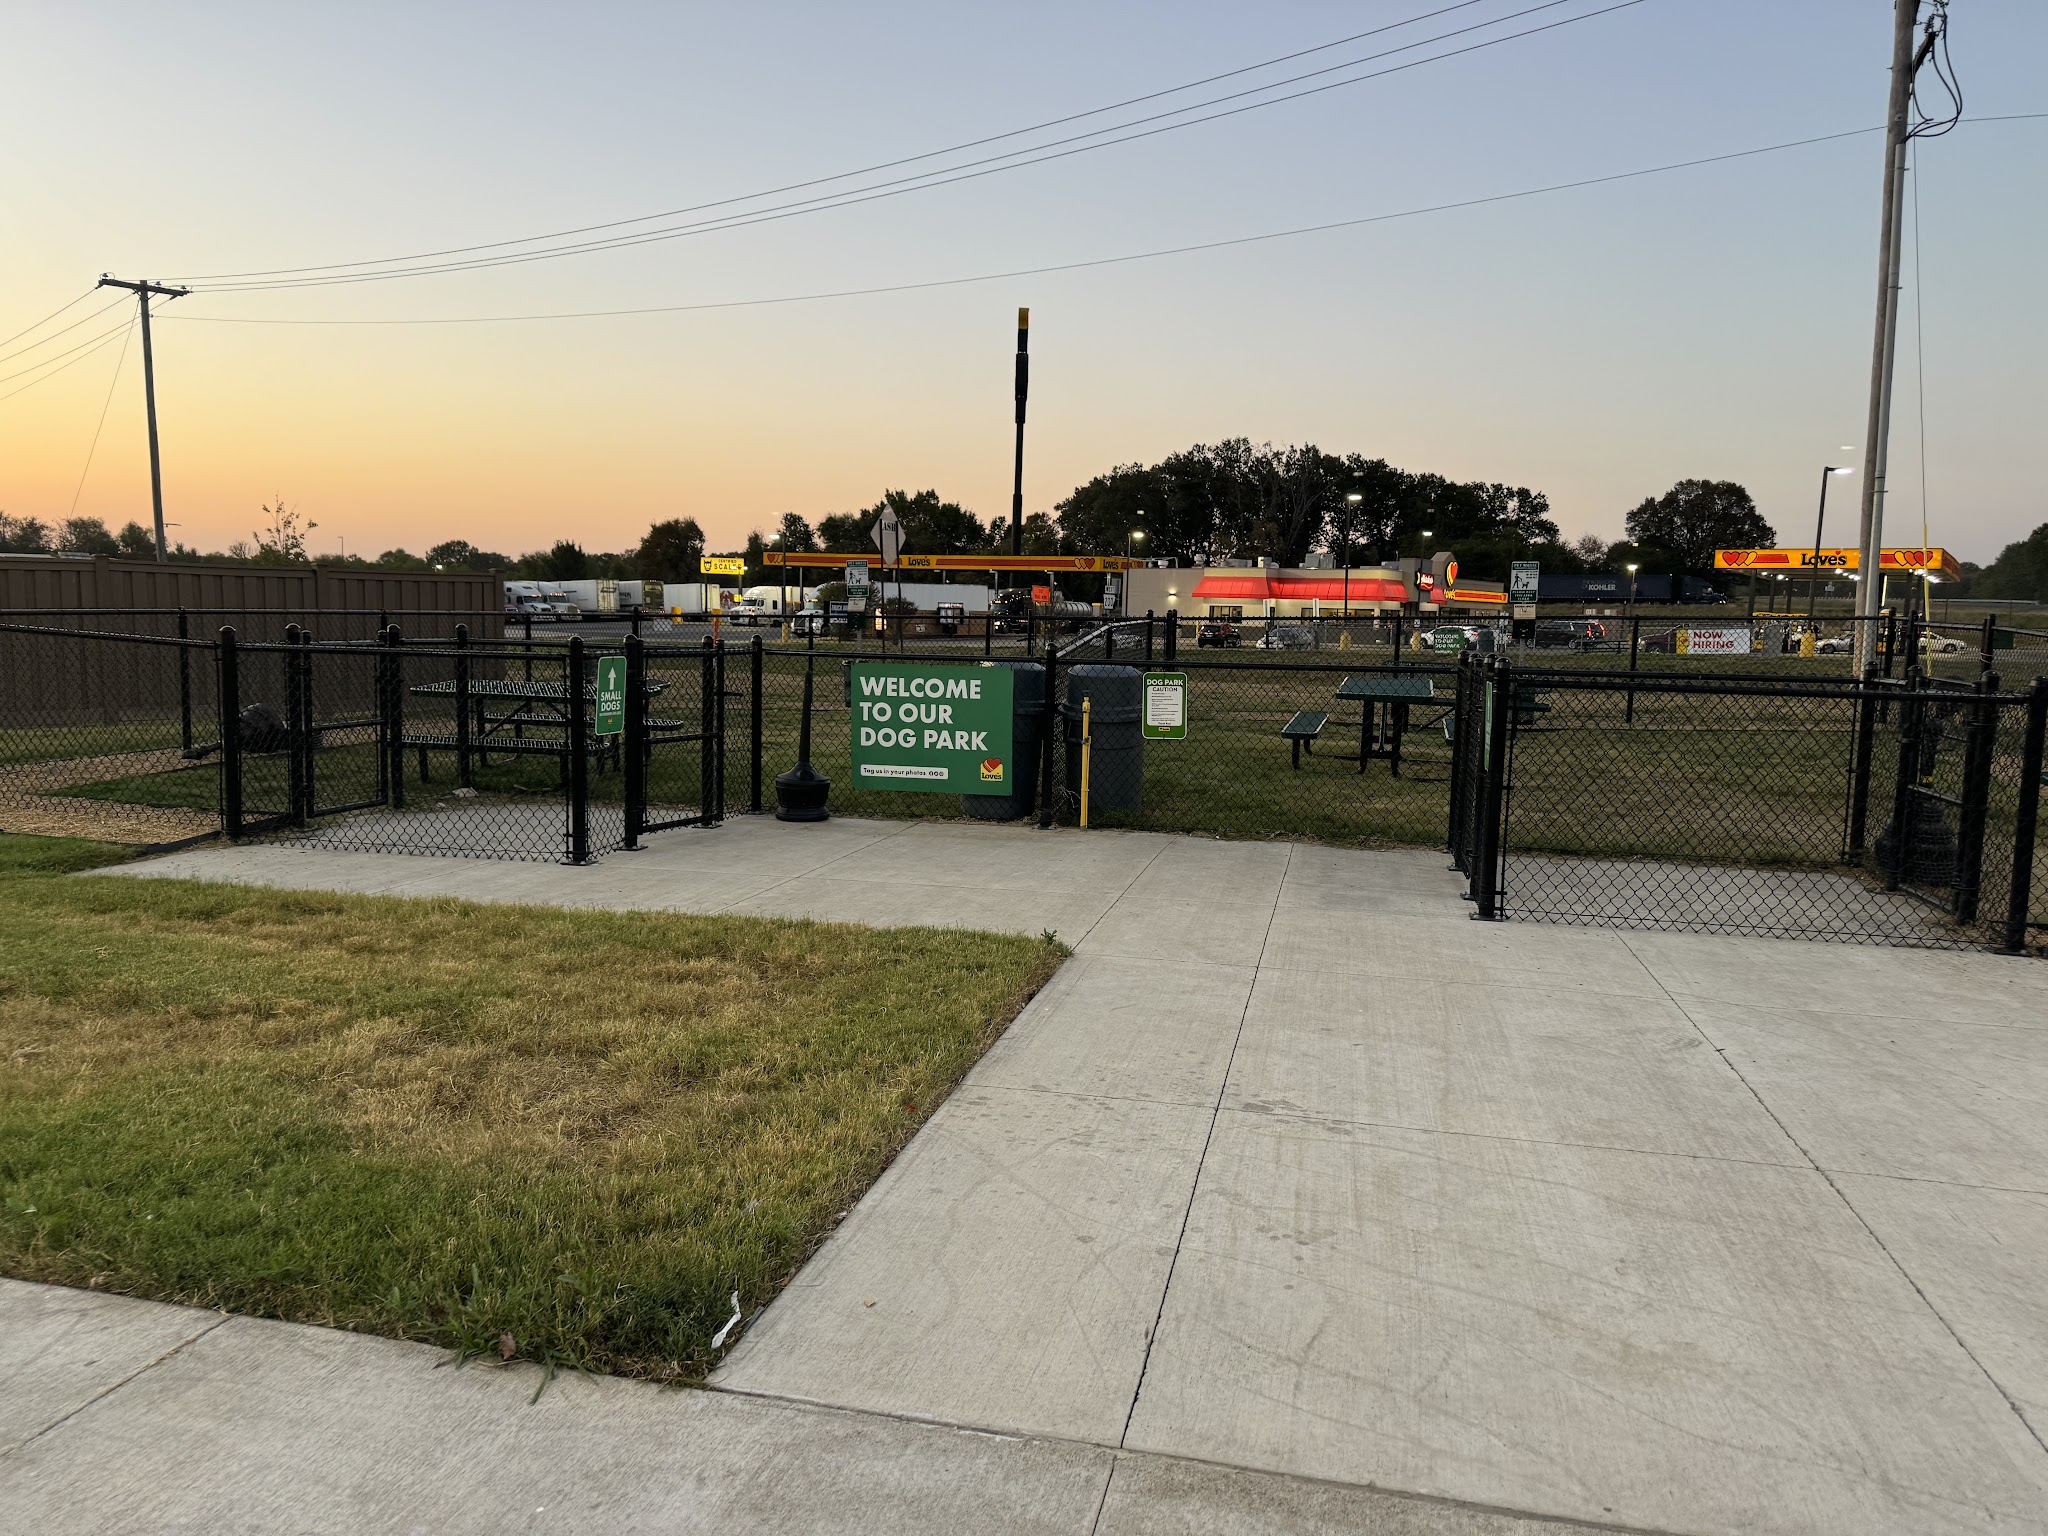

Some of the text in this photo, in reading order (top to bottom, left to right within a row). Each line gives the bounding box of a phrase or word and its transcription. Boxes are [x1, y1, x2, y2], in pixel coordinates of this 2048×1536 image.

[908, 556, 930, 566] Love's
[1801, 551, 1846, 566] Love's
[1103, 559, 1118, 570] Love's
[1693, 631, 1723, 639] NOW
[1693, 640, 1734, 648] HIRING
[859, 677, 981, 699] WELCOME
[601, 691, 621, 701] SMALL
[601, 701, 620, 711] DOGS
[859, 702, 953, 724] TO OUR
[860, 727, 988, 751] DOG PARK
[905, 768, 926, 776] photos
[981, 772, 1002, 780] Love's
